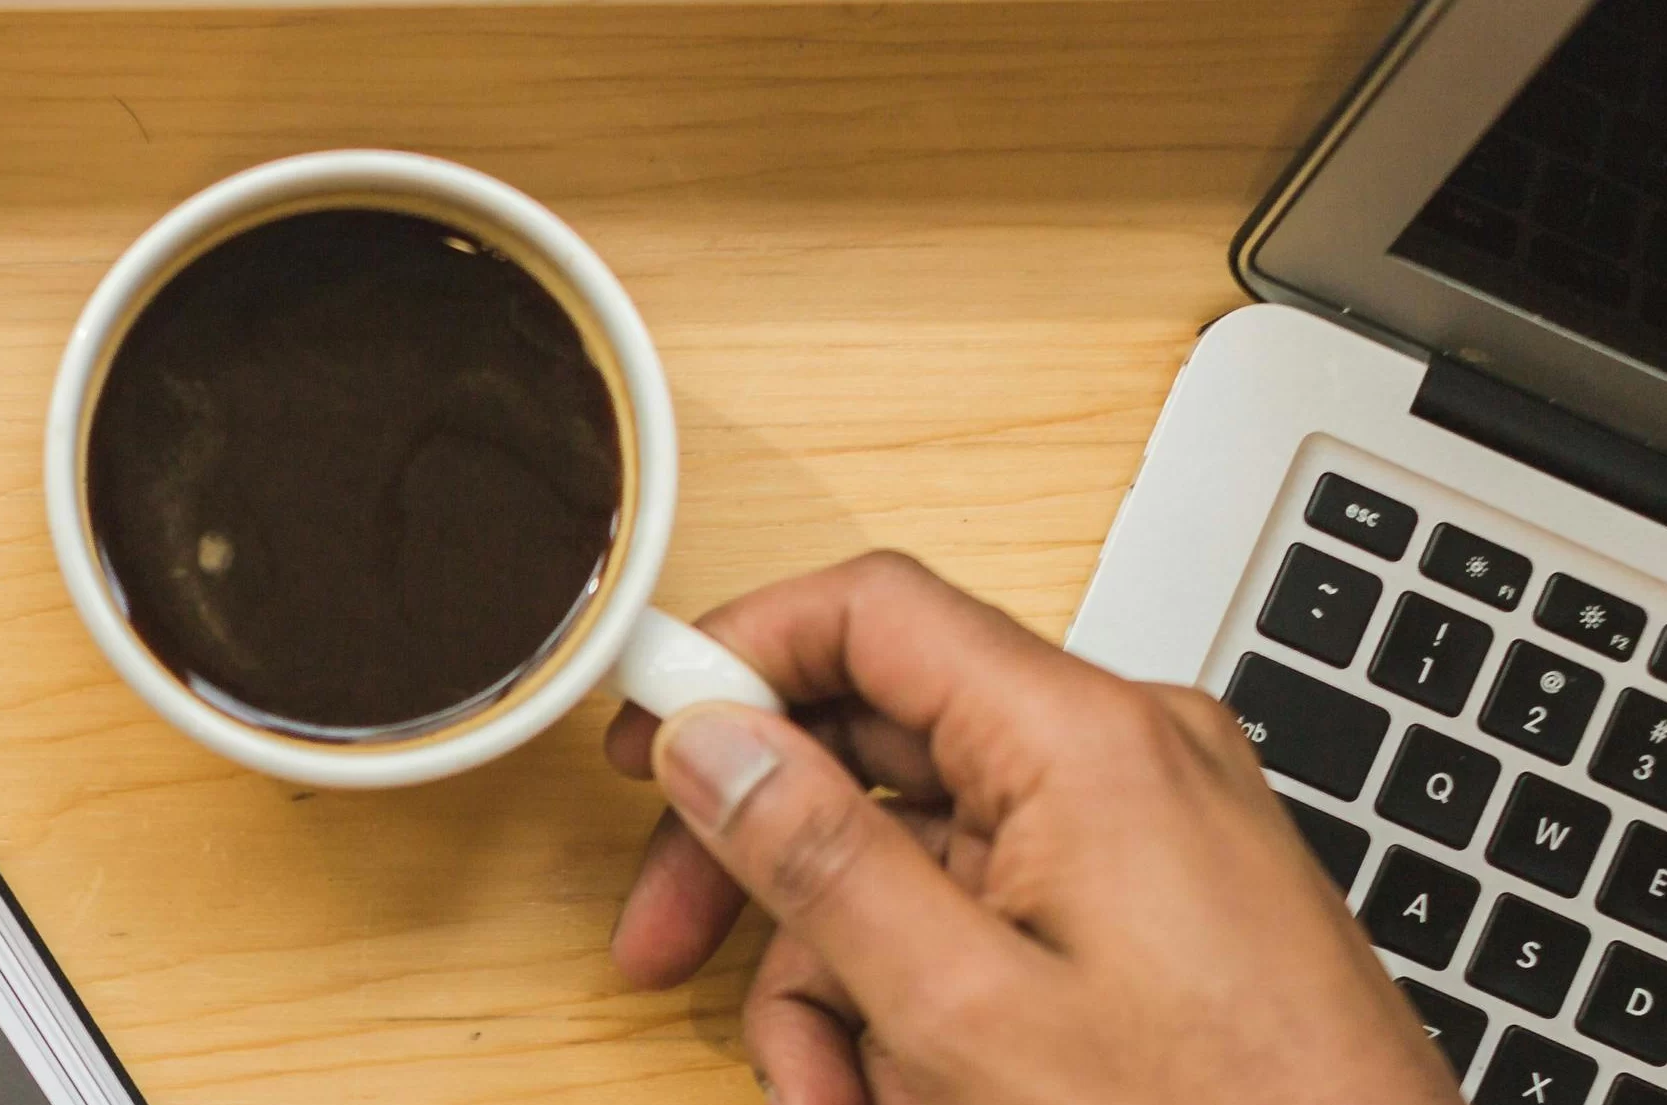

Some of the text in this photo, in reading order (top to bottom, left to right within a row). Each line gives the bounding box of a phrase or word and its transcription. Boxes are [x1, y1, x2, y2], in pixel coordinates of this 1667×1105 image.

[1345, 503, 1380, 528] esc
[1417, 657, 1434, 684] 1
[1522, 706, 1547, 734] 2
[1633, 754, 1654, 780] 3
[1426, 772, 1453, 804] Q
[1535, 817, 1571, 851] W
[1402, 893, 1428, 923] A
[1516, 941, 1541, 969] S
[1625, 987, 1653, 1016] D
[1521, 1072, 1553, 1104] X
